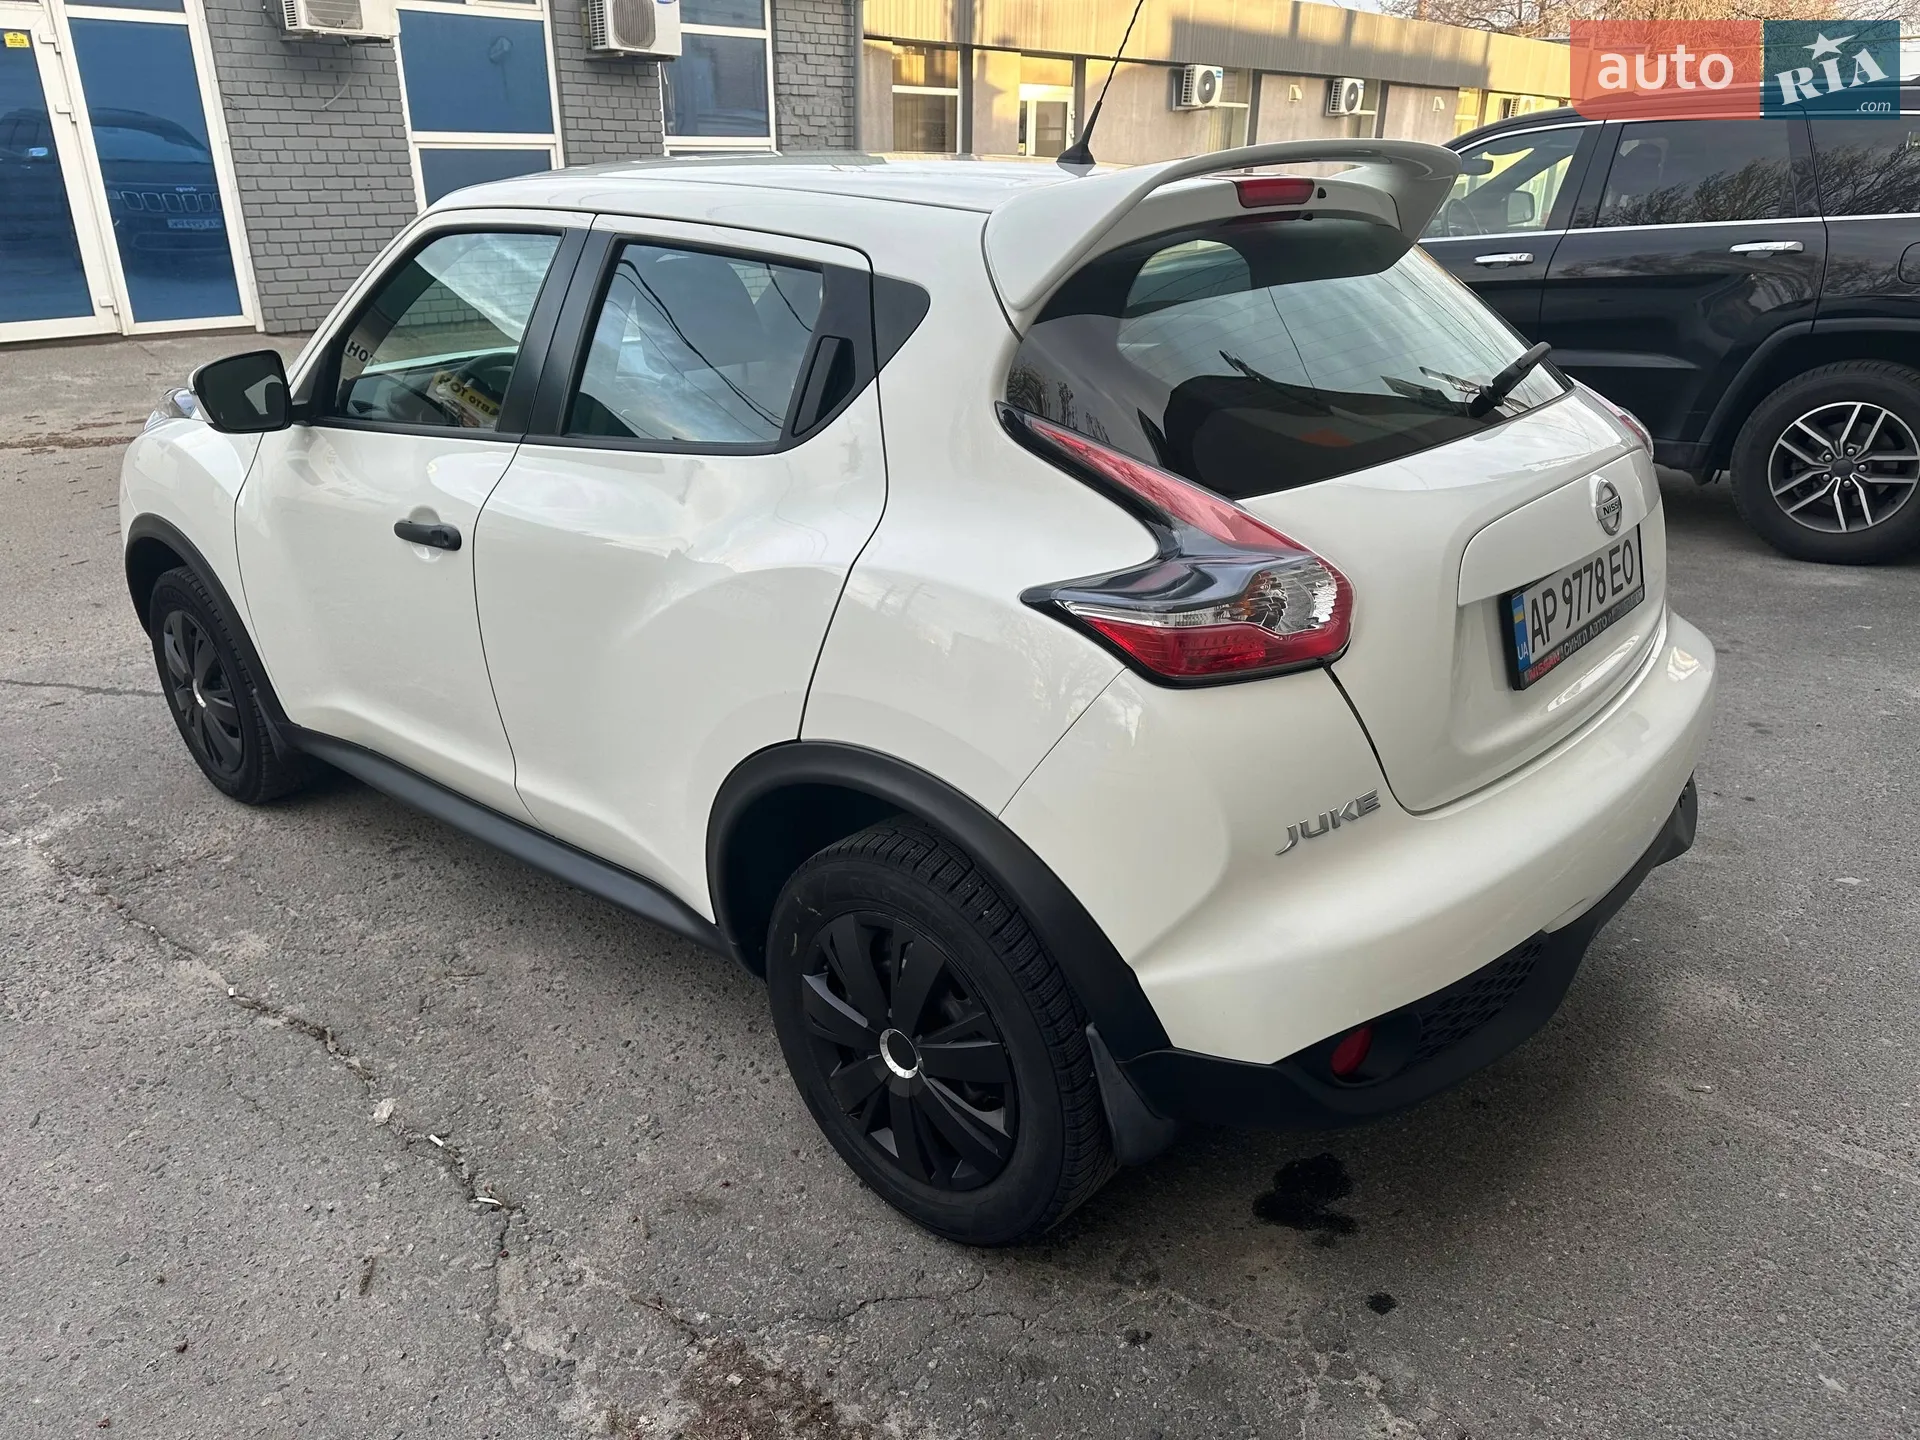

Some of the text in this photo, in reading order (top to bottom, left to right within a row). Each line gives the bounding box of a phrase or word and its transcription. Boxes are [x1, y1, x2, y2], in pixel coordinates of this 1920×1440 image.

[1531, 587, 1557, 653] AP
[1562, 556, 1606, 629] 9778
[1608, 539, 1634, 597] EO
[1516, 641, 1529, 660] UA
[1274, 788, 1381, 856] JUKE
